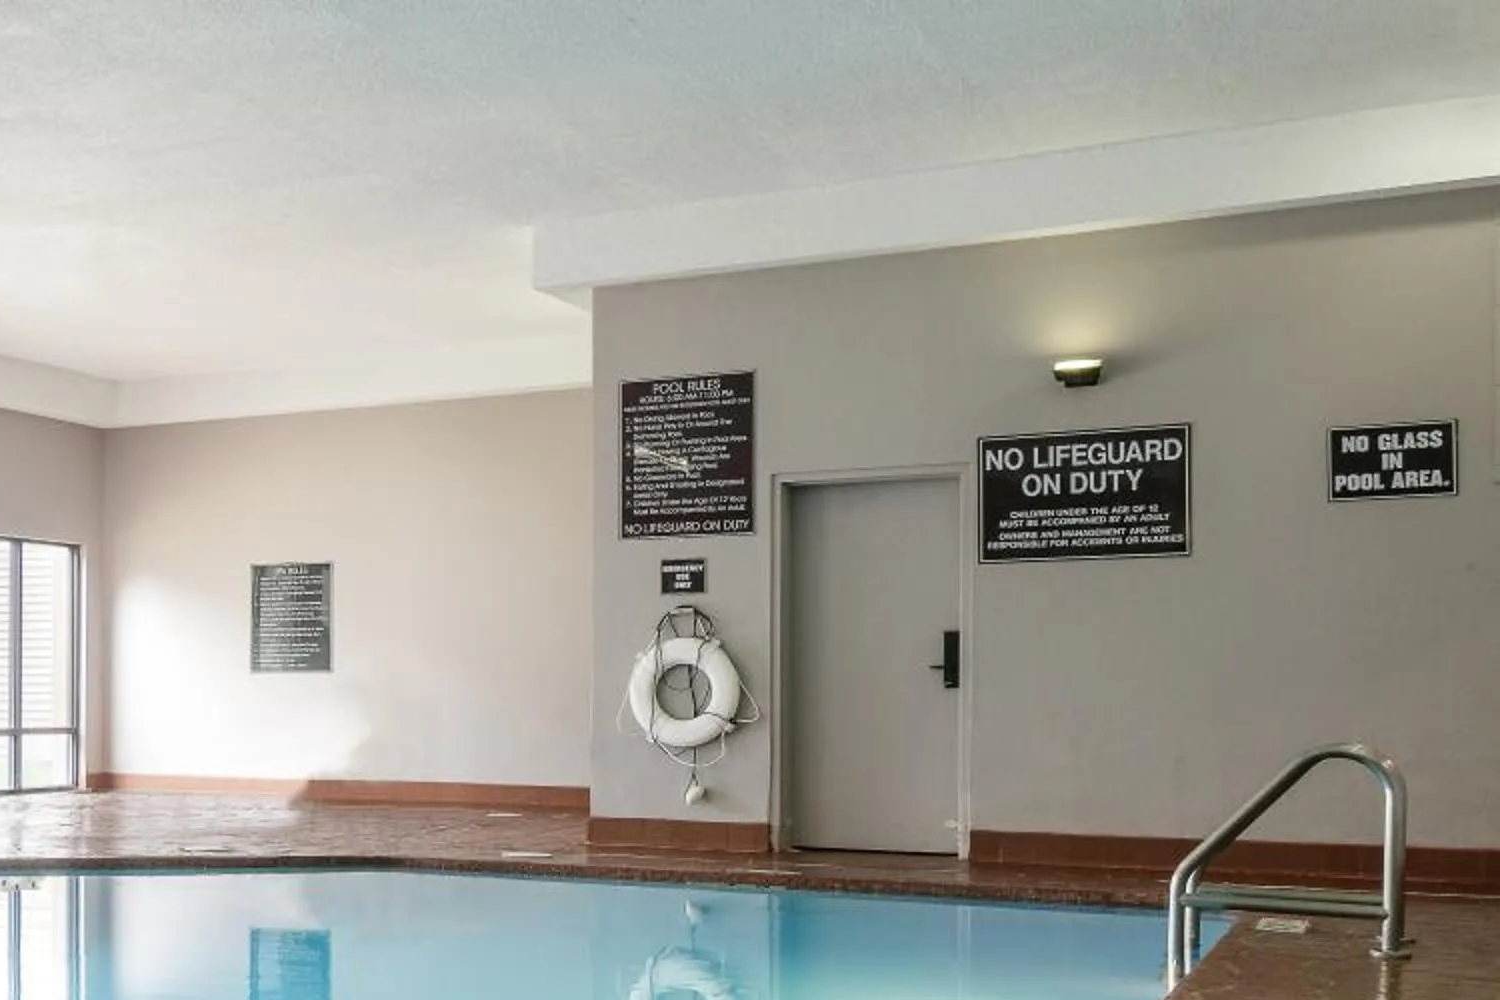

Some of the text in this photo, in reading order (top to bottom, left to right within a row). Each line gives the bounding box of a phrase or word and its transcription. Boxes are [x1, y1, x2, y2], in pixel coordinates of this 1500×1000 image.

[653, 378, 721, 394] POOL RULES
[1341, 429, 1444, 454] NO GLASS
[984, 437, 1184, 472] NO LIFEGUARD
[1381, 451, 1404, 471] IN
[1021, 468, 1144, 497] ON DUTY
[1335, 469, 1451, 493] POOL AREA.
[1090, 506, 1109, 515] THE
[1111, 505, 1131, 514] AGE
[1131, 503, 1148, 513] OF
[624, 518, 750, 535] NO LIFEGUARD ON DUTY
[999, 519, 1025, 529] MUST
[1041, 515, 1107, 527] ACCOMPANIED
[1108, 515, 1122, 523] BY
[1123, 514, 1138, 522] AN
[1140, 512, 1171, 521] ADULT
[1040, 529, 1060, 539] AND
[1129, 526, 1149, 535] ARE
[1150, 525, 1172, 534] NOT
[1049, 538, 1069, 548] FOR
[1125, 534, 1140, 545] OR
